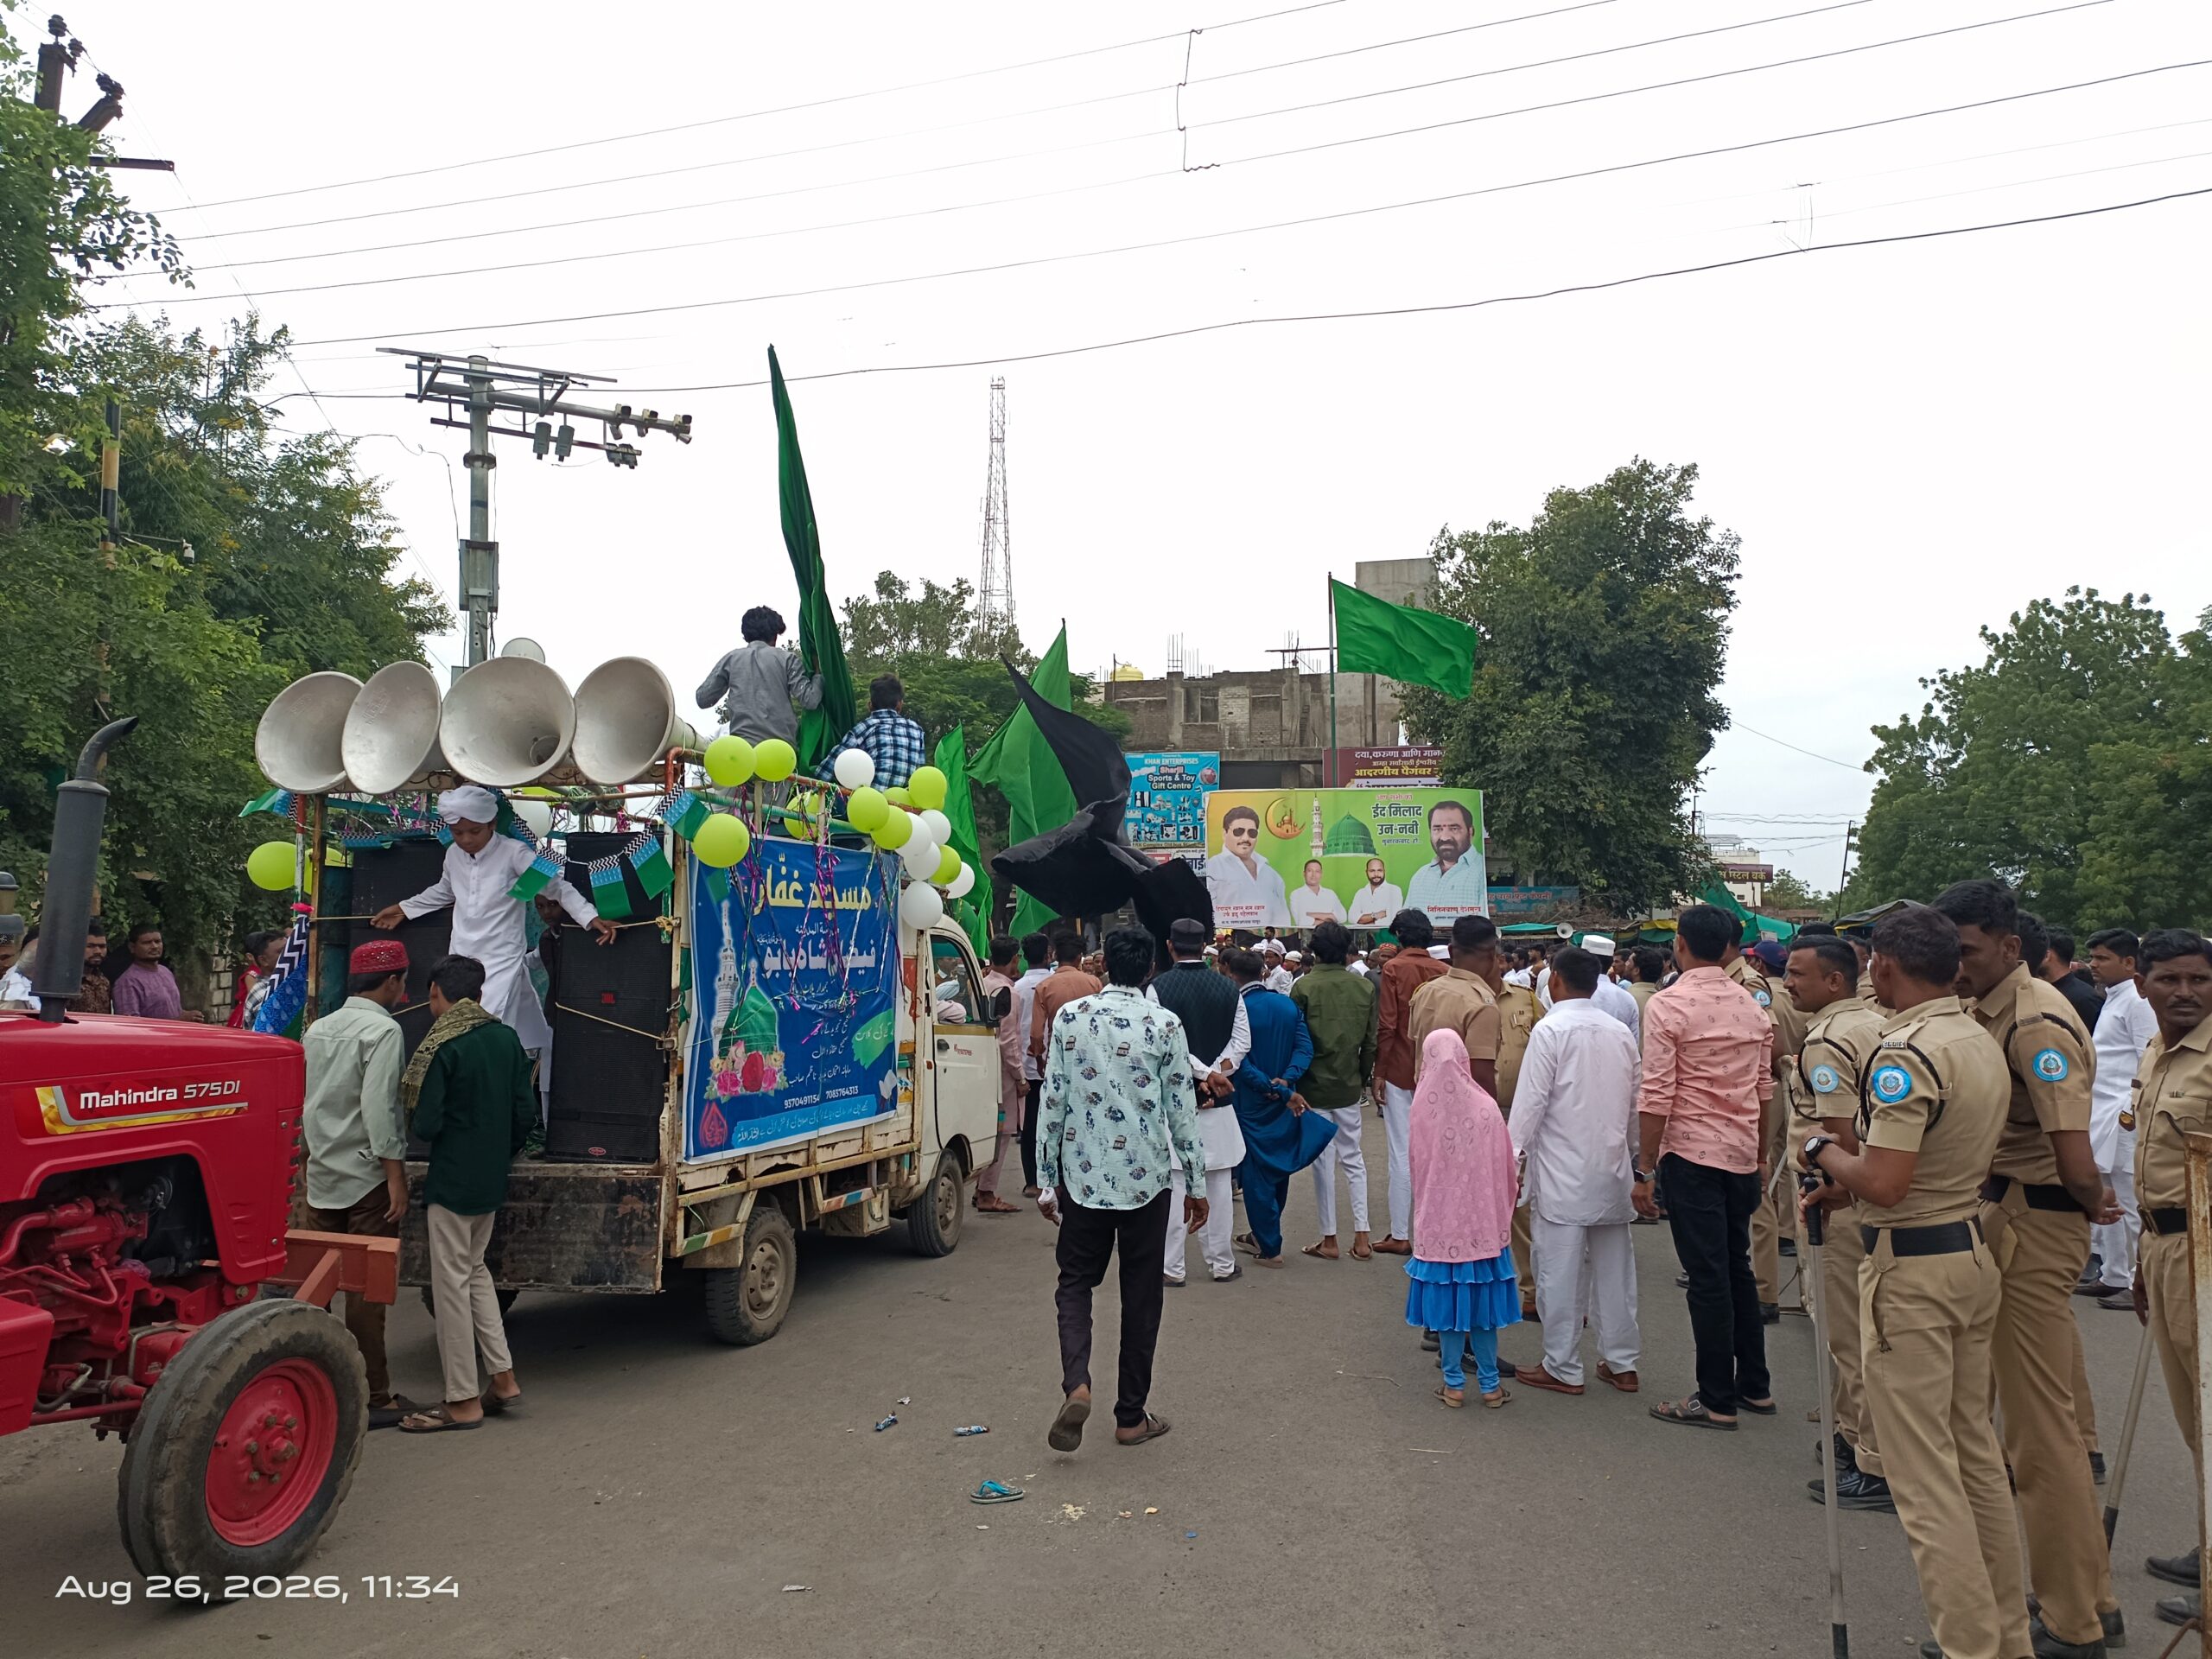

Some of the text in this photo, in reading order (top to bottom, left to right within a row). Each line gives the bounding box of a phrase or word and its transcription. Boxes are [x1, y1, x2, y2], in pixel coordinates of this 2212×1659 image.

[1401, 747, 1421, 758] आणि
[1355, 766, 1398, 777] आदरणीय
[1372, 803, 1422, 818] ईद मिलाद
[1377, 820, 1419, 835] उन-नबी
[1729, 868, 1750, 880] स्टिल
[1751, 868, 1766, 880] वर्क
[80, 1086, 177, 1109] Mahindra
